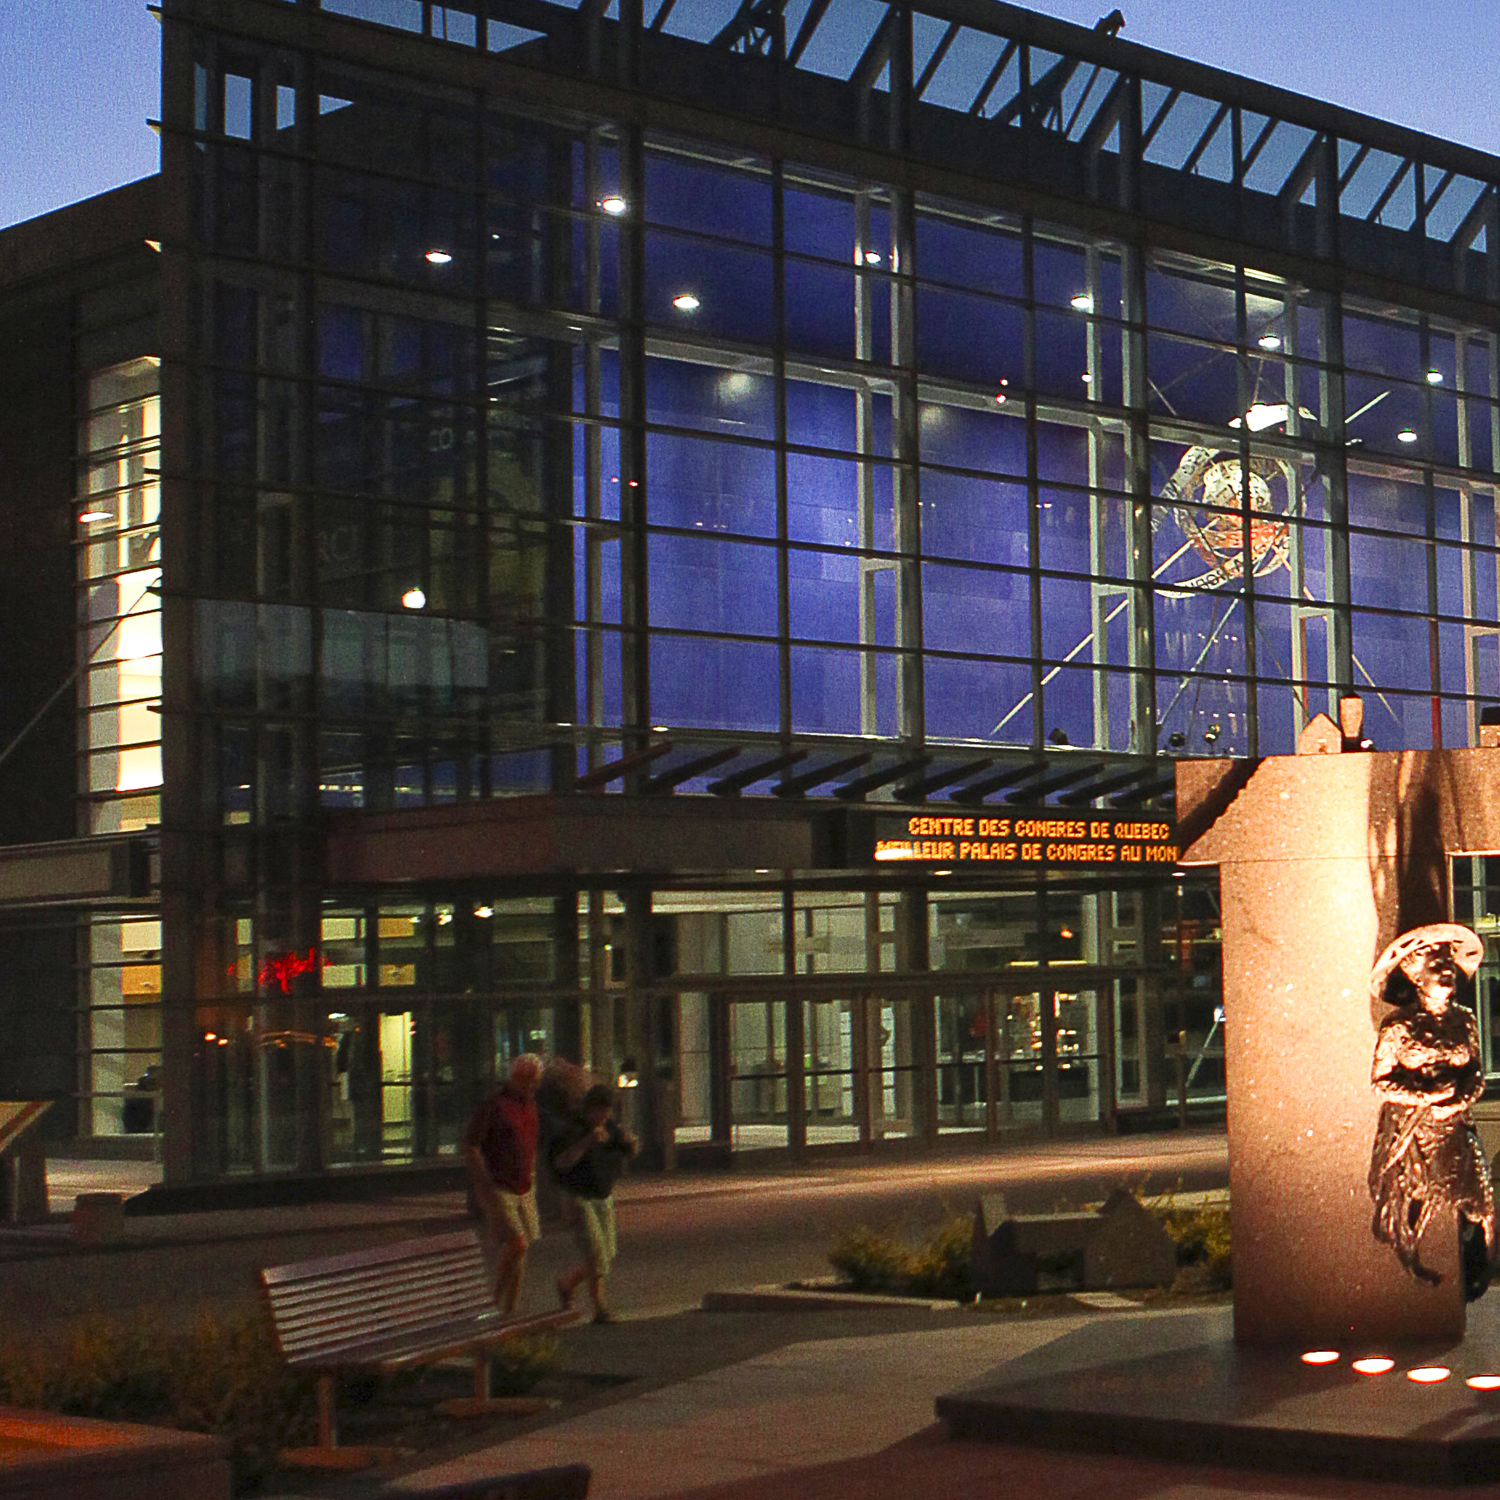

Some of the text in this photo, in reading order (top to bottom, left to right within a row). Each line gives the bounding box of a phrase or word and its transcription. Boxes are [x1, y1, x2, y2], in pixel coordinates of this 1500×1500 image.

[909, 817, 1169, 840] CENTRE DES CONGRES DE QUEBEC
[960, 841, 1017, 860] PALAIS
[1021, 843, 1042, 861] DE
[1046, 843, 1116, 861] CONGRES
[1120, 844, 1142, 862] AU
[1145, 845, 1180, 862] MON
